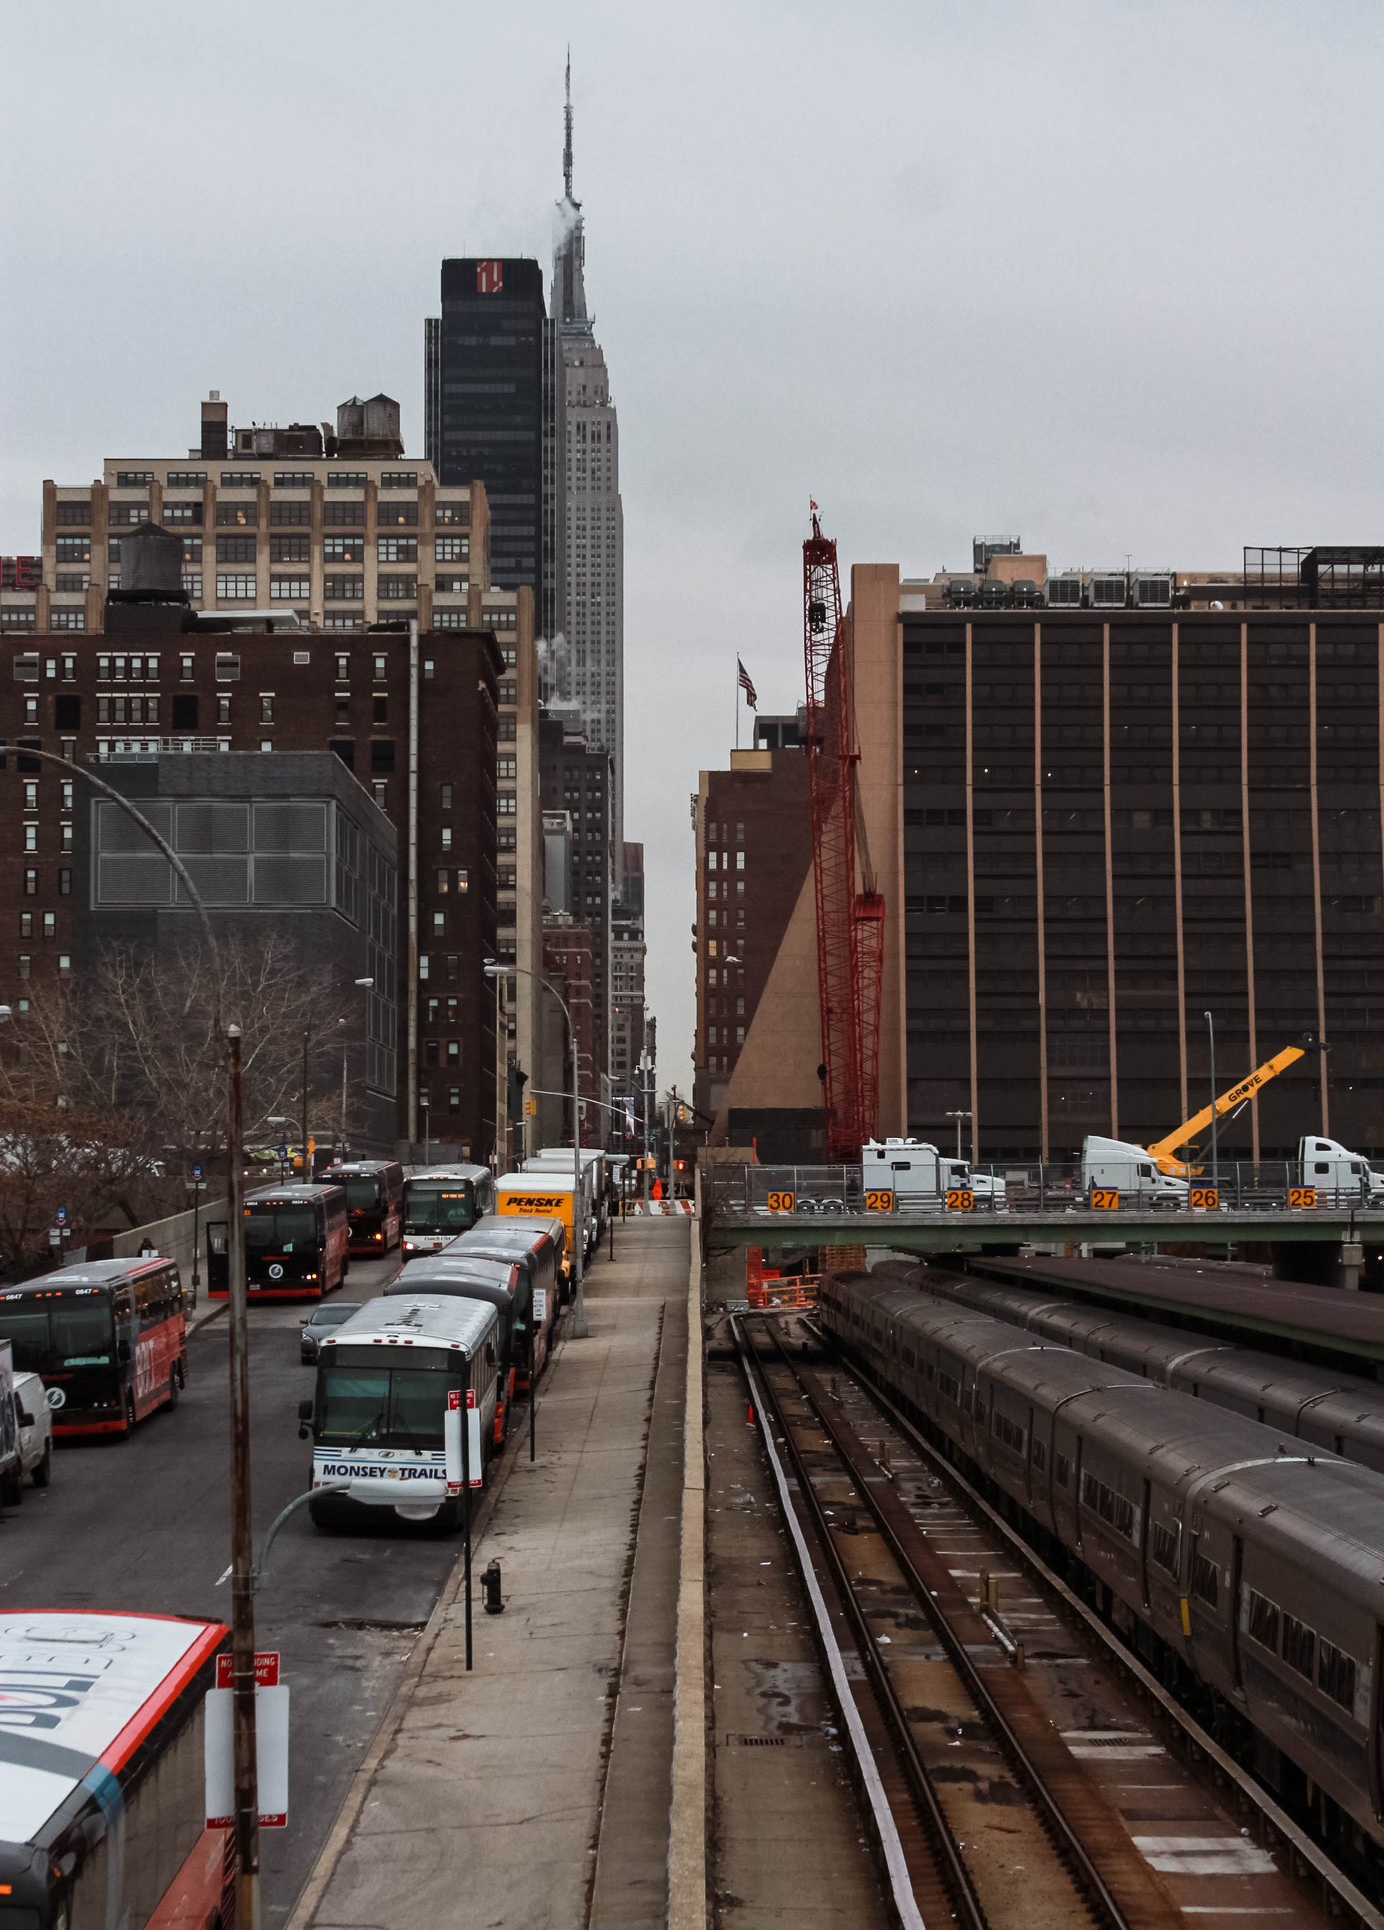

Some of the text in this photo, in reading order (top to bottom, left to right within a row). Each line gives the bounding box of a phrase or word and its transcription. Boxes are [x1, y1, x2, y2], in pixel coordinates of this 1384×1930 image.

[1228, 1074, 1262, 1102] GROVE
[506, 1197, 565, 1207] PENSKE
[769, 1192, 794, 1210] 30
[867, 1192, 891, 1210] 29
[948, 1191, 973, 1208] 28
[1093, 1191, 1117, 1208] 27
[1192, 1190, 1216, 1207] 26
[1290, 1189, 1315, 1207] 25
[323, 1464, 388, 1478] MONSEY
